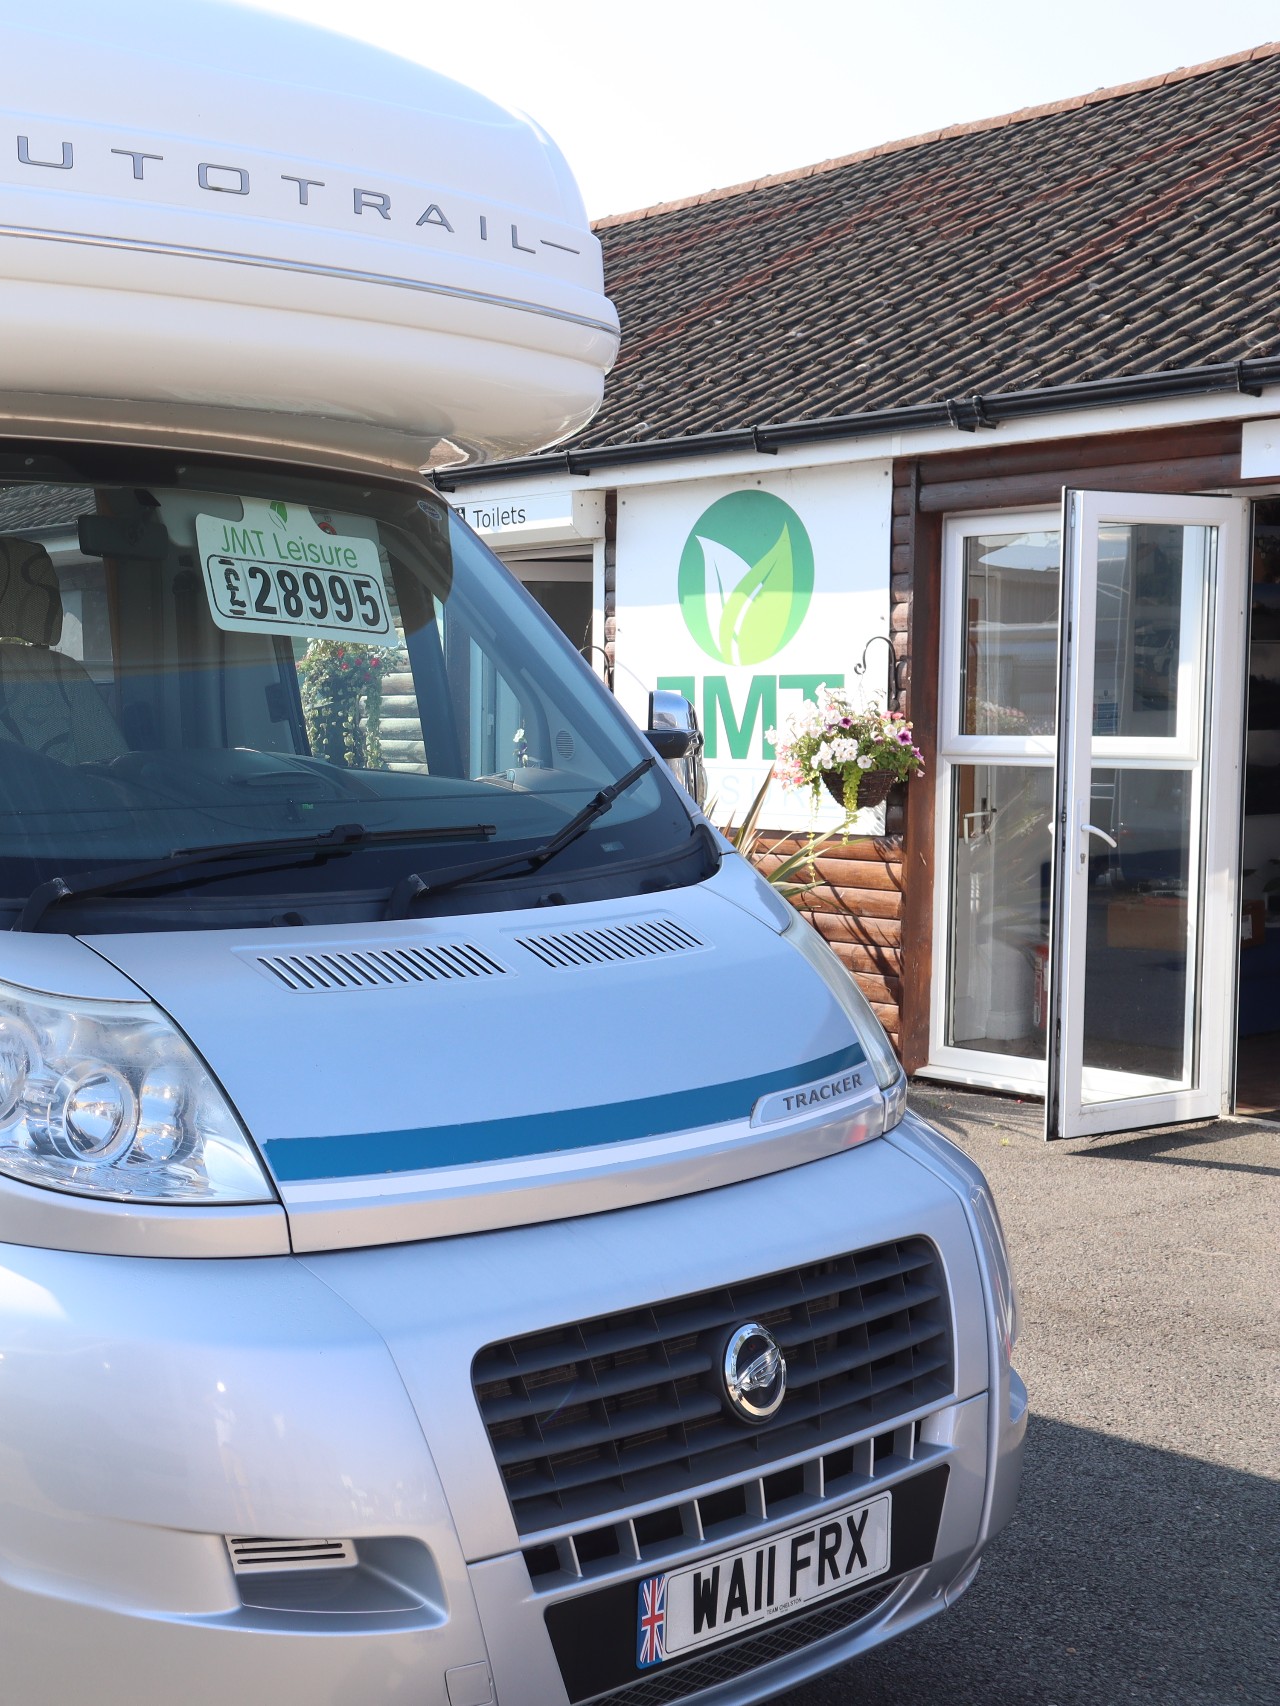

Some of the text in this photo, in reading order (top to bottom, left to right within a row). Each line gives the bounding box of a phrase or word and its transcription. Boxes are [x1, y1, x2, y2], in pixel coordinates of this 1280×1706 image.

[473, 506, 526, 529] Toilets
[221, 525, 359, 569] JMT Leisure
[223, 566, 381, 627] £28995
[782, 1073, 864, 1111] TRACKER
[789, 1509, 869, 1598] FRX
